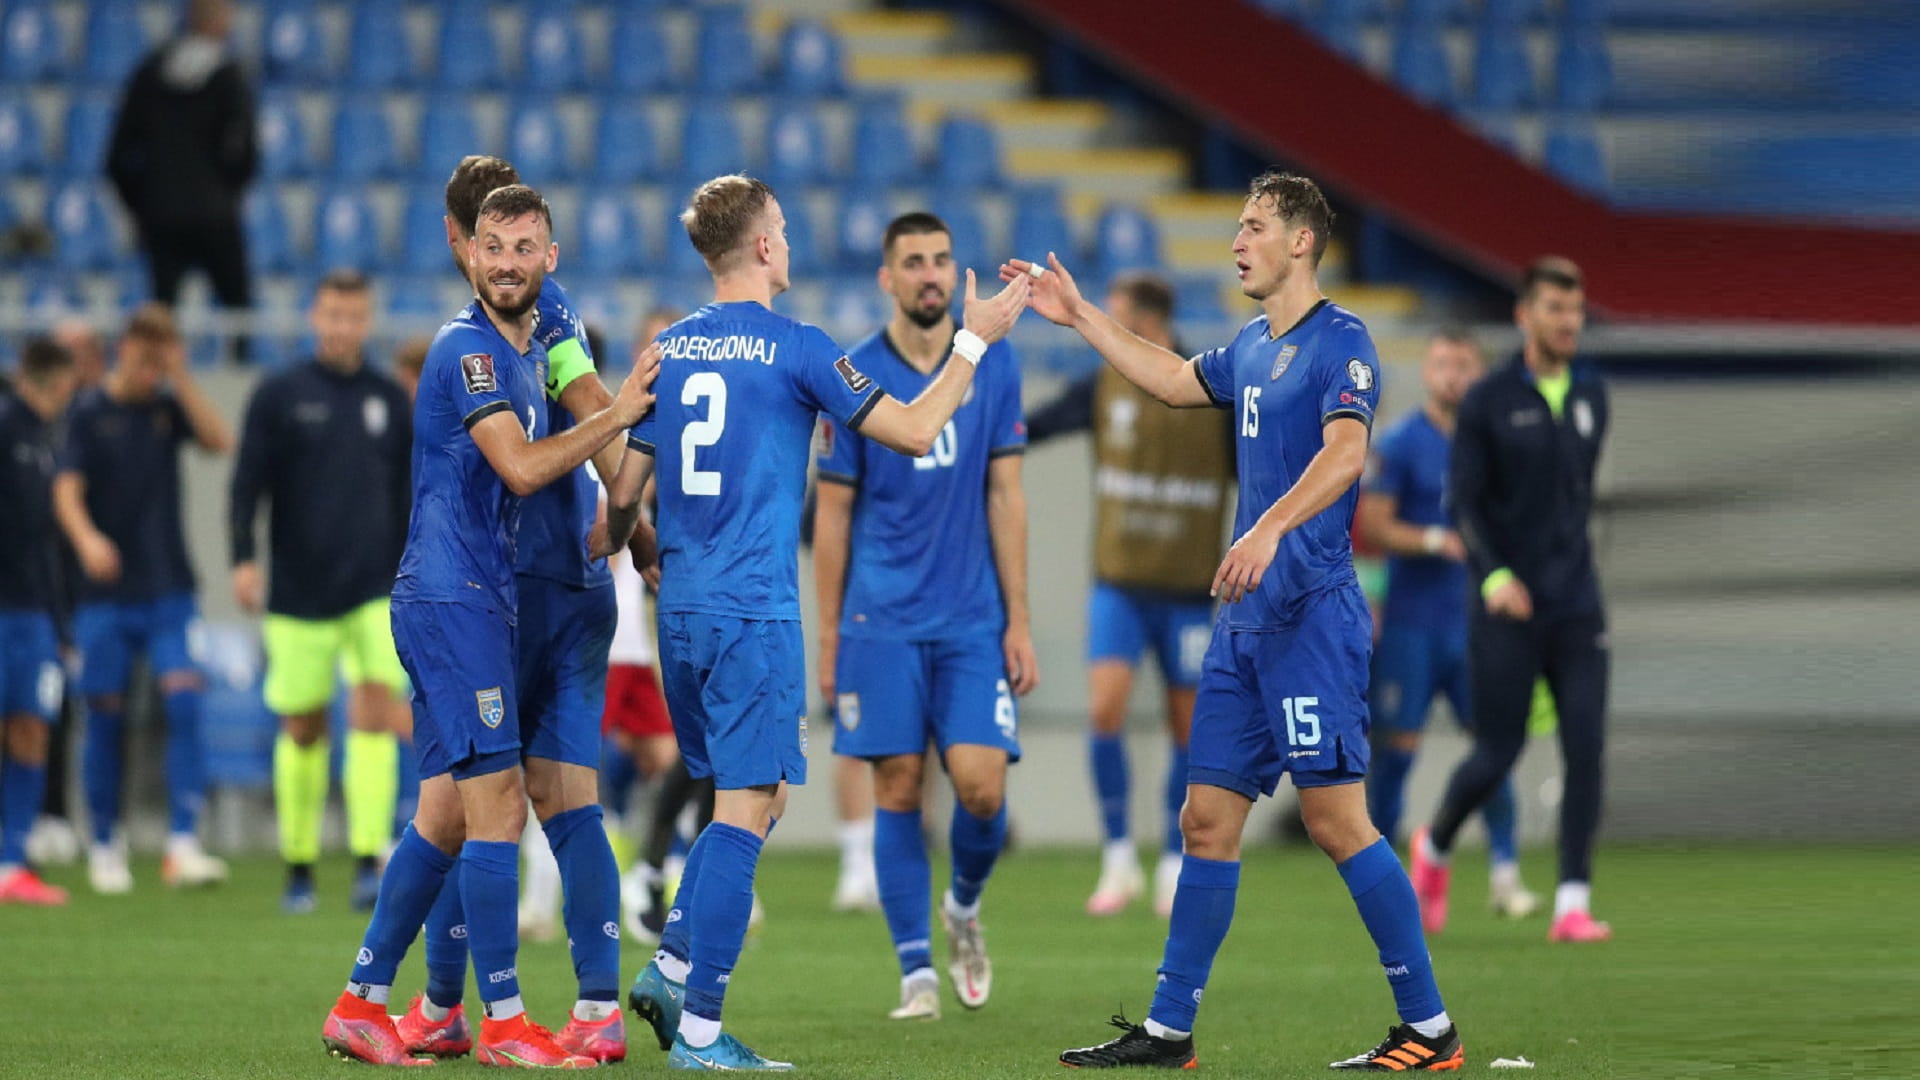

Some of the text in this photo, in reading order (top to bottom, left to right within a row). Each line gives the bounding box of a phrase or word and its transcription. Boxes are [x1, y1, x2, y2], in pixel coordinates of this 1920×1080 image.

[681, 372, 728, 496] 2
[1242, 385, 1263, 438] 15
[913, 419, 958, 470] 0
[1282, 696, 1322, 746] 15
